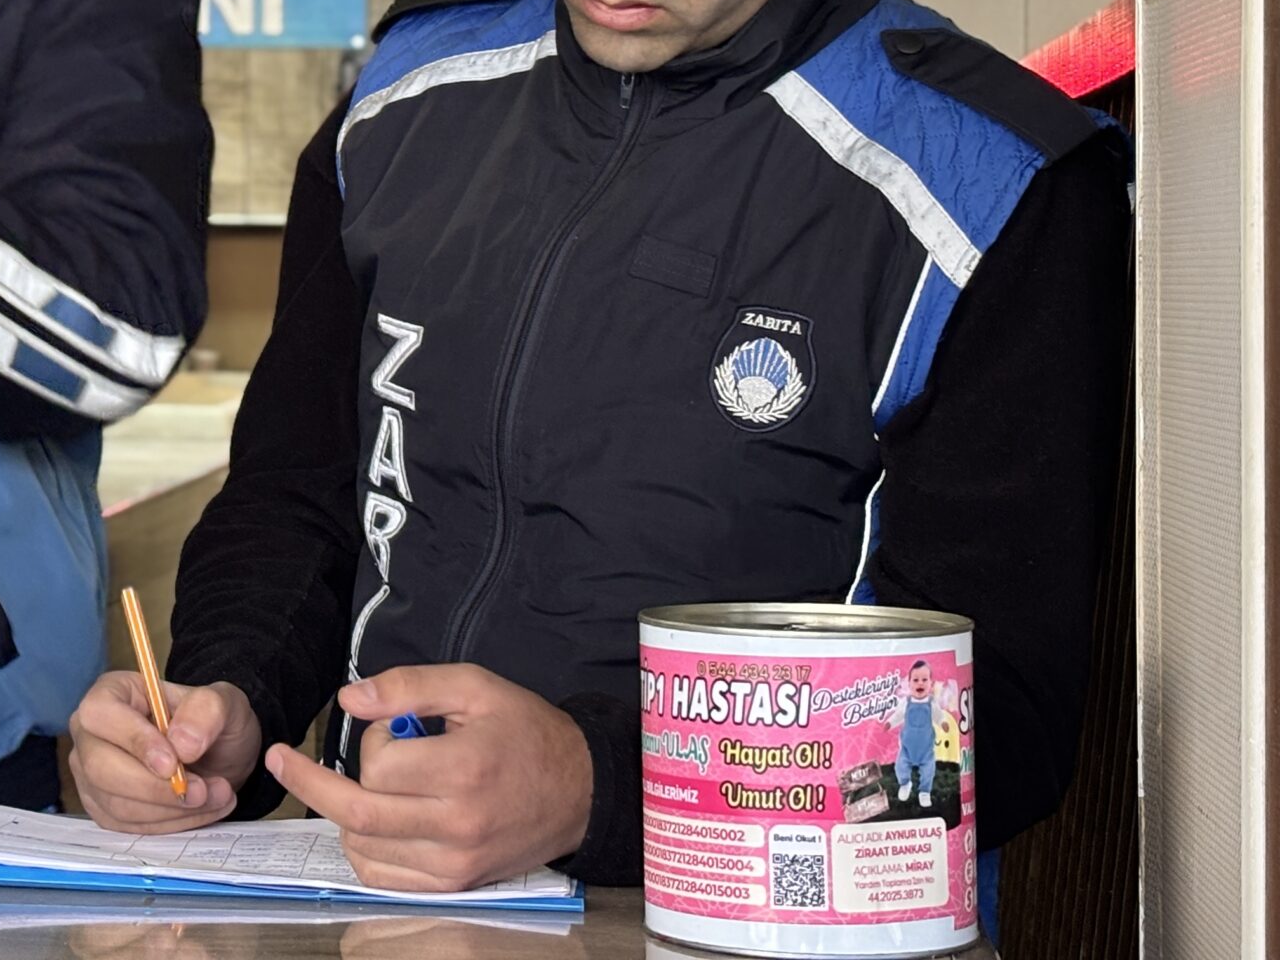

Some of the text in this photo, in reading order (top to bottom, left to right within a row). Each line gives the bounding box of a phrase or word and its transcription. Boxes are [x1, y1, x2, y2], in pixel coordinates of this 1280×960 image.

[741, 312, 802, 335] ZABITA
[740, 663, 769, 680] 434
[773, 664, 792, 681] 23
[795, 665, 812, 682] 17
[671, 674, 812, 727] HASTASI
[812, 671, 899, 712] Desteklerinizi
[843, 695, 898, 726] Bekliyor
[662, 730, 710, 775] ULAŞ
[719, 738, 791, 774] Hayat
[720, 781, 786, 811] Umut
[773, 833, 793, 842] Beni
[885, 829, 917, 840] AYNUR
[919, 827, 942, 840] ULAŞ
[854, 843, 932, 858] ZİRAAT BANKASI
[905, 859, 935, 872] MİRAY
